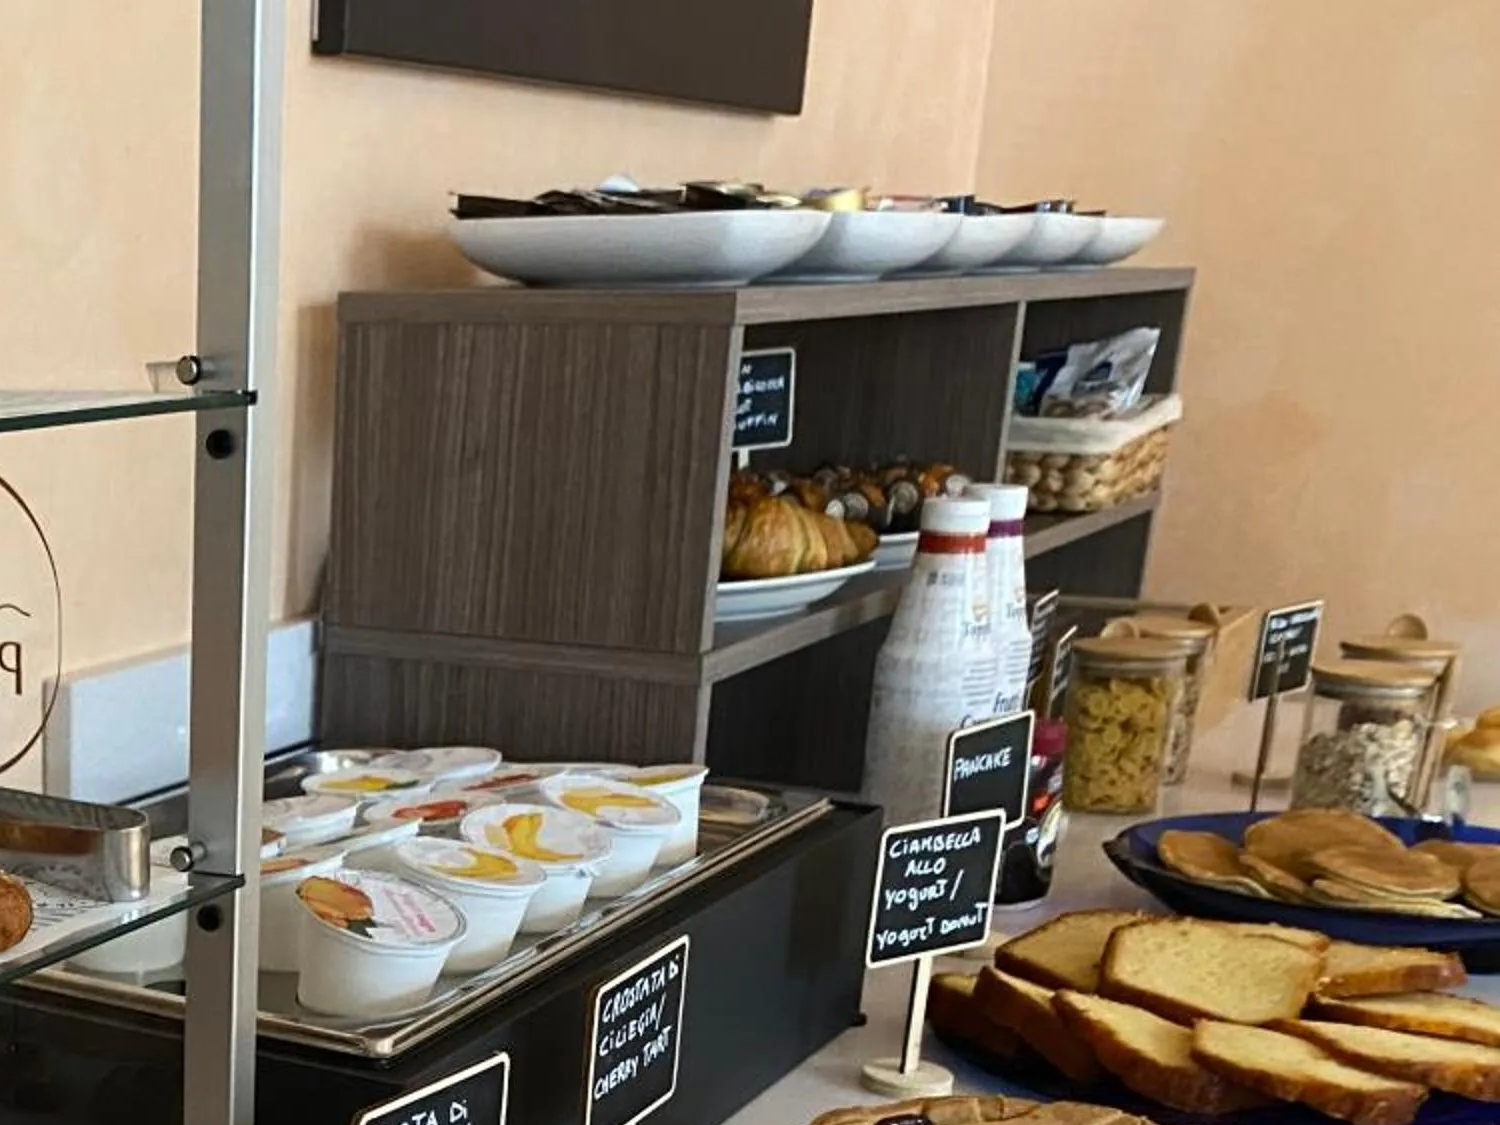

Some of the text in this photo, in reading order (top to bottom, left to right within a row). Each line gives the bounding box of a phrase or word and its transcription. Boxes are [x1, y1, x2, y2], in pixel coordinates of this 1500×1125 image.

[953, 747, 1012, 781] PANCAKE
[905, 858, 946, 877] ALLO
[643, 1025, 673, 1067] TART
